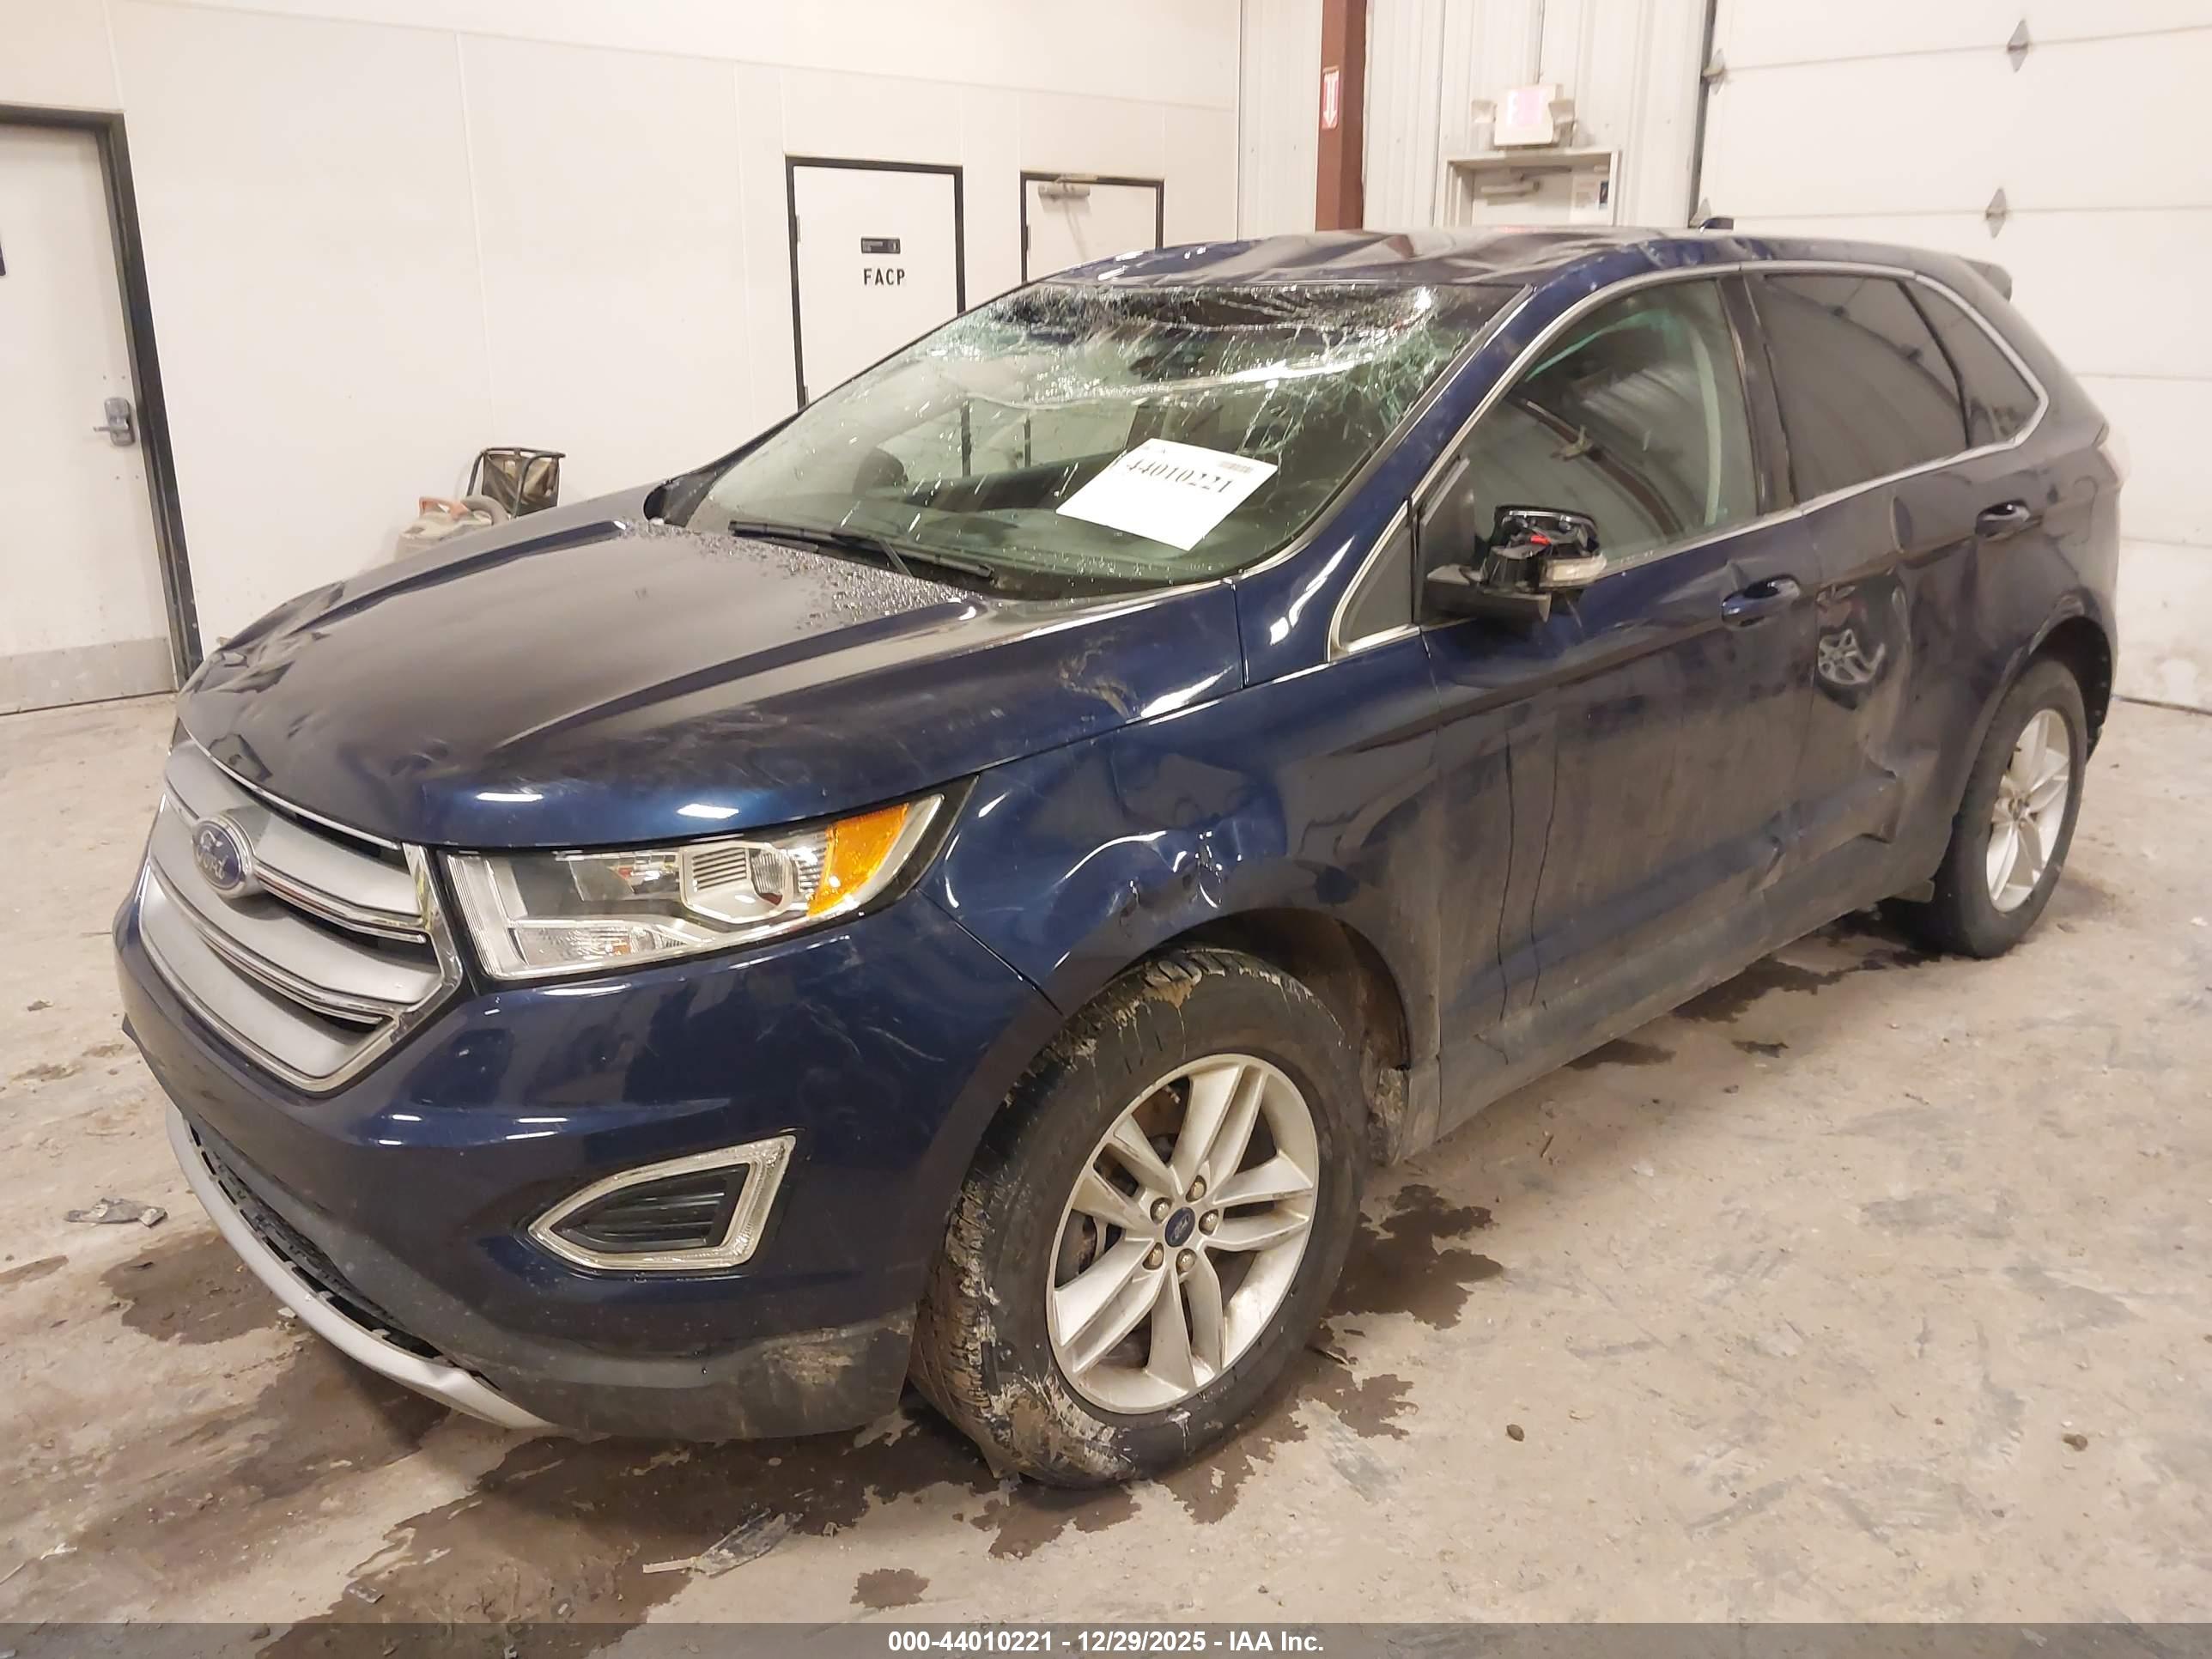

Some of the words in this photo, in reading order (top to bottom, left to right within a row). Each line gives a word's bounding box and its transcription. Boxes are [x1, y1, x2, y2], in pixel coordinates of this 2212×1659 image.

[864, 268, 905, 285] FACP
[1127, 459, 1232, 493] 44010221
[197, 830, 229, 880] Ford
